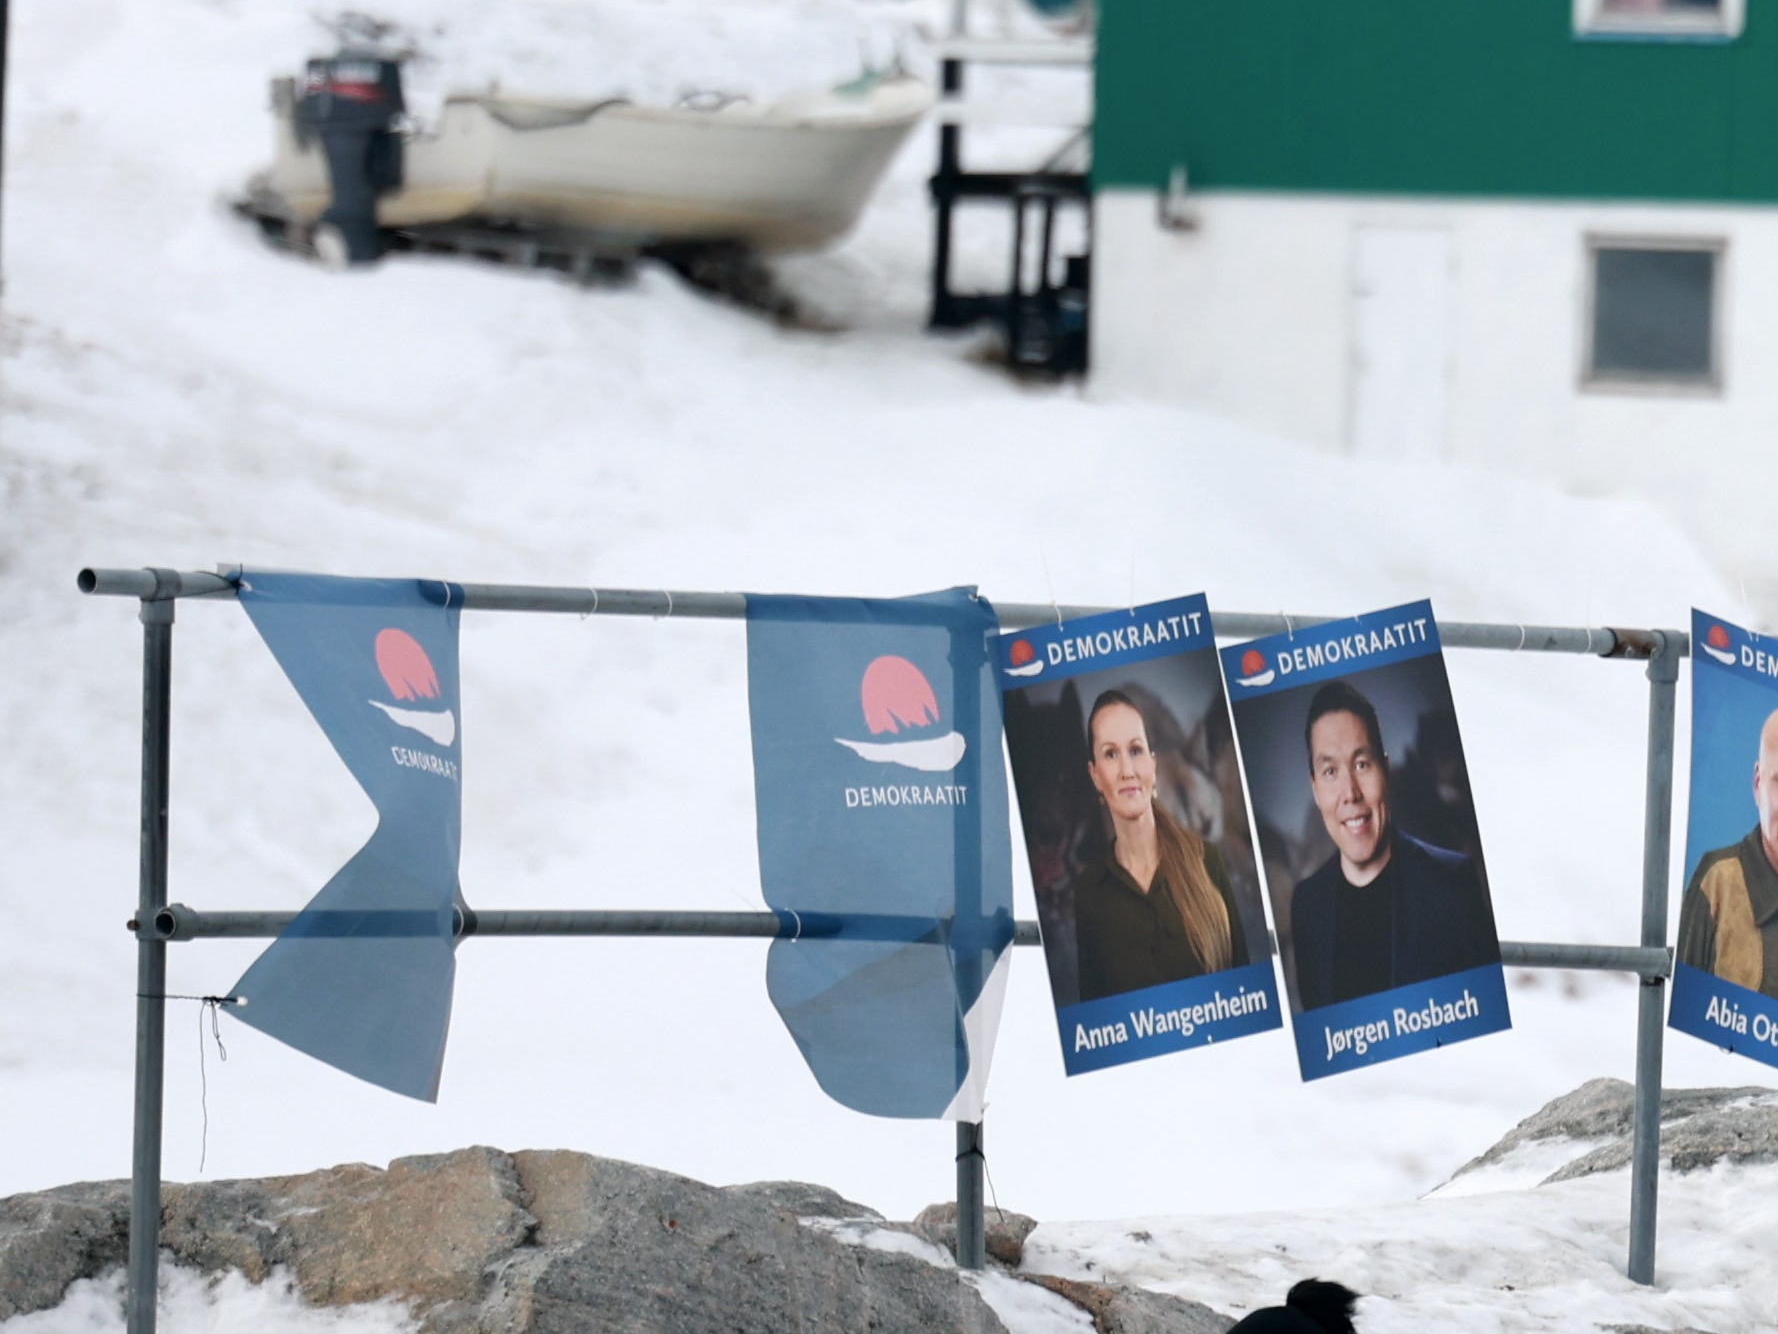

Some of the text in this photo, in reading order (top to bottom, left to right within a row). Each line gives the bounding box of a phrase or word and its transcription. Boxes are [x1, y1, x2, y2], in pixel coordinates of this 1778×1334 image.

[1046, 612, 1202, 666] DEMOKRAATIT
[1277, 619, 1429, 676] DEMOKRAATIT
[844, 785, 968, 808] DEMOKRAATIT
[1074, 986, 1268, 1053] Anna Wangenheim
[1323, 990, 1479, 1061] Jørgen Rosbach
[1705, 995, 1748, 1037] Abia
